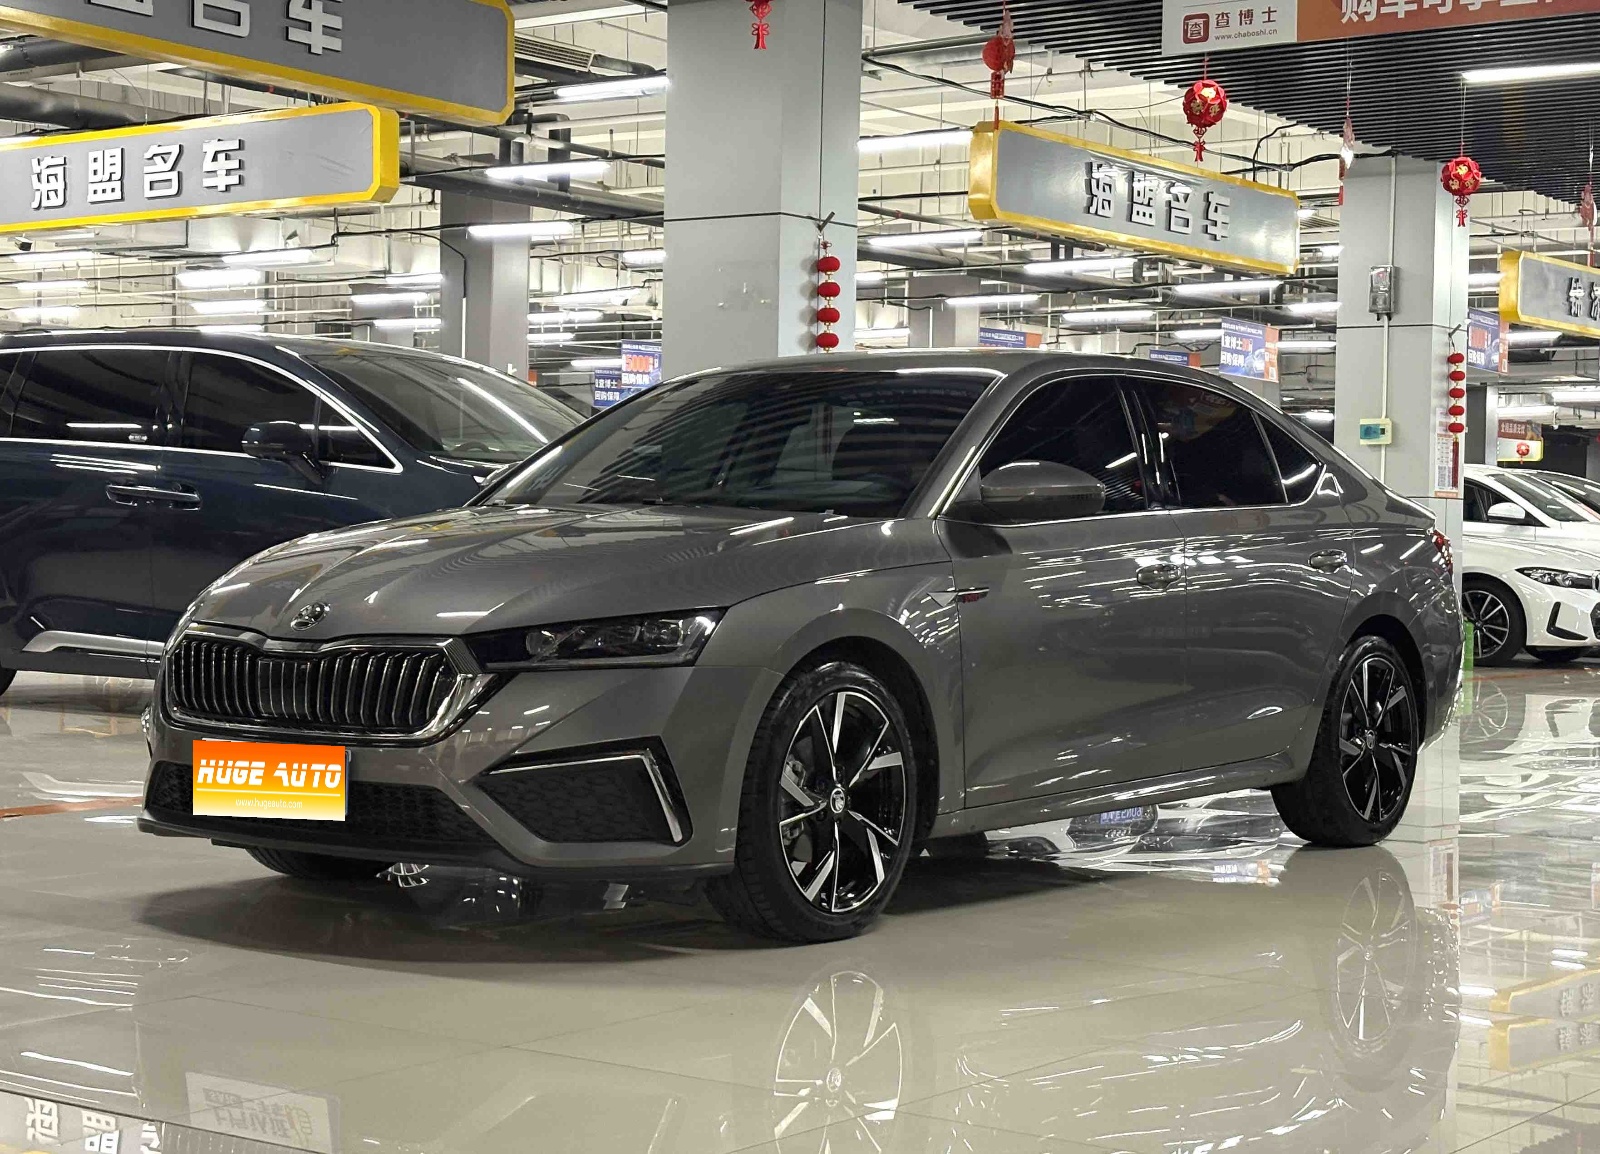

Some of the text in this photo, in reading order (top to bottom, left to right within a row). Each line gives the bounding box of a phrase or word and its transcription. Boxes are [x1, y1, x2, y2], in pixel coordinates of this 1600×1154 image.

[1214, 6, 1278, 29] 查博士
[1214, 28, 1278, 41] www.chaboshi.cn
[31, 138, 243, 210] 海盟名车
[1087, 161, 1232, 242] 海盟名车
